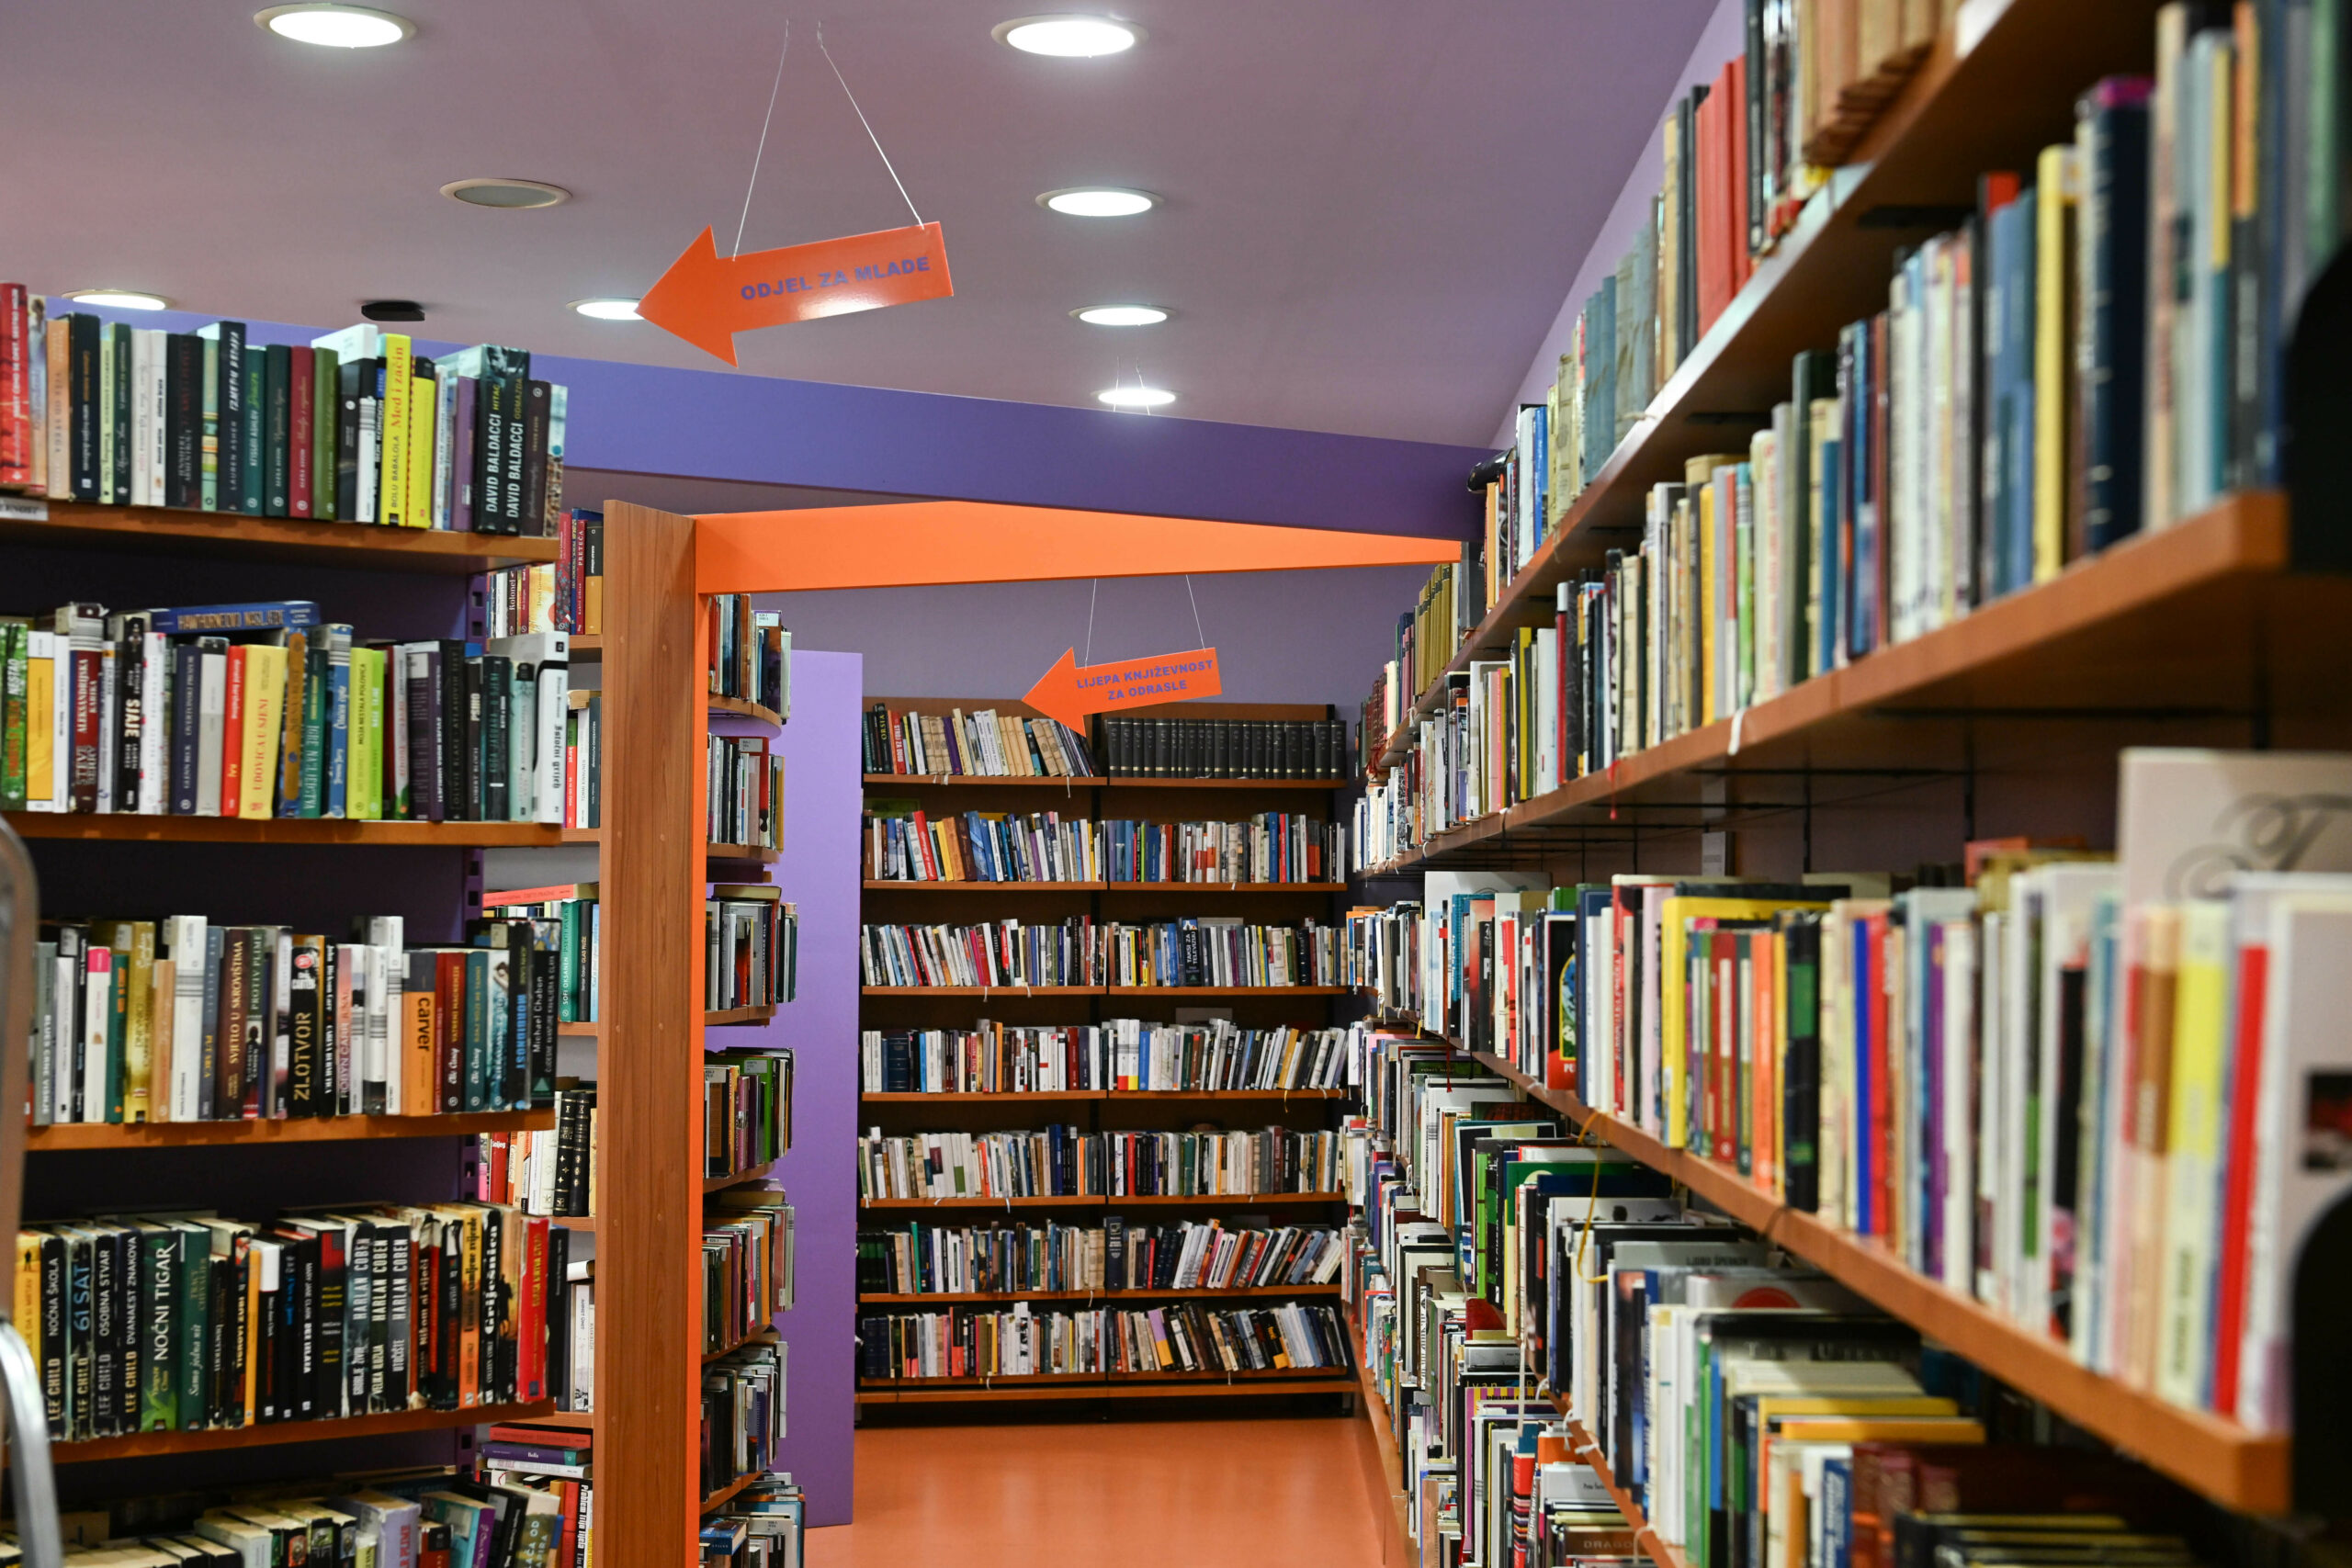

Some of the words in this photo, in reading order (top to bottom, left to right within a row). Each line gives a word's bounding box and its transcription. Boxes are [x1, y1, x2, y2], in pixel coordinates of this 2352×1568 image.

[741, 276, 812, 299] ODJEL
[820, 270, 849, 288] ZA
[854, 256, 930, 281] MLADE
[391, 346, 403, 385] začin
[390, 397, 402, 428] Med
[487, 413, 501, 474] BALDACCI
[509, 423, 524, 480] BALDACCI
[485, 478, 499, 513] DAVID
[507, 482, 521, 518] DAVID
[1077, 673, 1120, 689] LIJEPA
[1125, 660, 1213, 682] KNJIŽEVNOST
[1108, 690, 1125, 700] ZA
[1128, 680, 1187, 697] ODRASLE
[77, 660, 88, 733] ALEKSANDRIJSKA
[89, 681, 97, 713] KARIKA
[257, 699, 268, 728] SJENI
[125, 699, 140, 738] SJAJE
[308, 725, 320, 747] IGRE
[879, 714, 888, 740] ORSIA
[76, 745, 86, 786] STEVE
[253, 740, 266, 790] UDOVICA
[249, 935, 261, 967] PLIME
[1185, 933, 1191, 942] ZA
[230, 942, 243, 1009] SKROVIŠTIMA
[249, 970, 260, 1010] PROTIV
[533, 976, 543, 1012] Chabon
[43, 1014, 52, 1046] BLUES
[230, 1012, 240, 1021] U
[417, 998, 432, 1051] carver
[532, 1015, 542, 1053] Michael
[228, 1023, 240, 1064] SVJETLO
[293, 1012, 311, 1100] ZLOTVOR
[339, 1022, 349, 1055] CARR
[42, 1048, 51, 1077] CRNE
[339, 1058, 349, 1099] ROBYN
[99, 1250, 110, 1286] STVAR
[127, 1236, 137, 1286] ZNAKOVA
[155, 1242, 177, 1301] TIGAR
[353, 1238, 370, 1271] COBEN
[372, 1240, 388, 1274] COBEN
[392, 1239, 408, 1272] COBEN
[47, 1258, 59, 1294] ŠKOLA
[74, 1264, 89, 1304] SAT
[99, 1290, 110, 1337] OSOBNA
[353, 1277, 368, 1320] HARLAN
[372, 1279, 387, 1321] HARLAN
[392, 1278, 408, 1320] HARLAN
[74, 1310, 90, 1330] 61
[126, 1291, 136, 1345] DVANAEST
[419, 1309, 429, 1346] Nikom
[98, 1354, 111, 1391] CHILD
[125, 1351, 137, 1388] CHILD
[391, 1339, 405, 1371] UTOČIŠTE
[48, 1359, 61, 1395] CHILD
[77, 1357, 88, 1393] CHILD
[188, 1370, 200, 1397] Samo
[372, 1371, 384, 1394] VELIKA
[49, 1400, 62, 1420] LEE
[78, 1399, 88, 1419] LEE
[98, 1395, 110, 1415] LEE
[125, 1393, 137, 1413] LEE
[580, 1484, 589, 1515] Problem
[530, 1521, 539, 1537] OD
